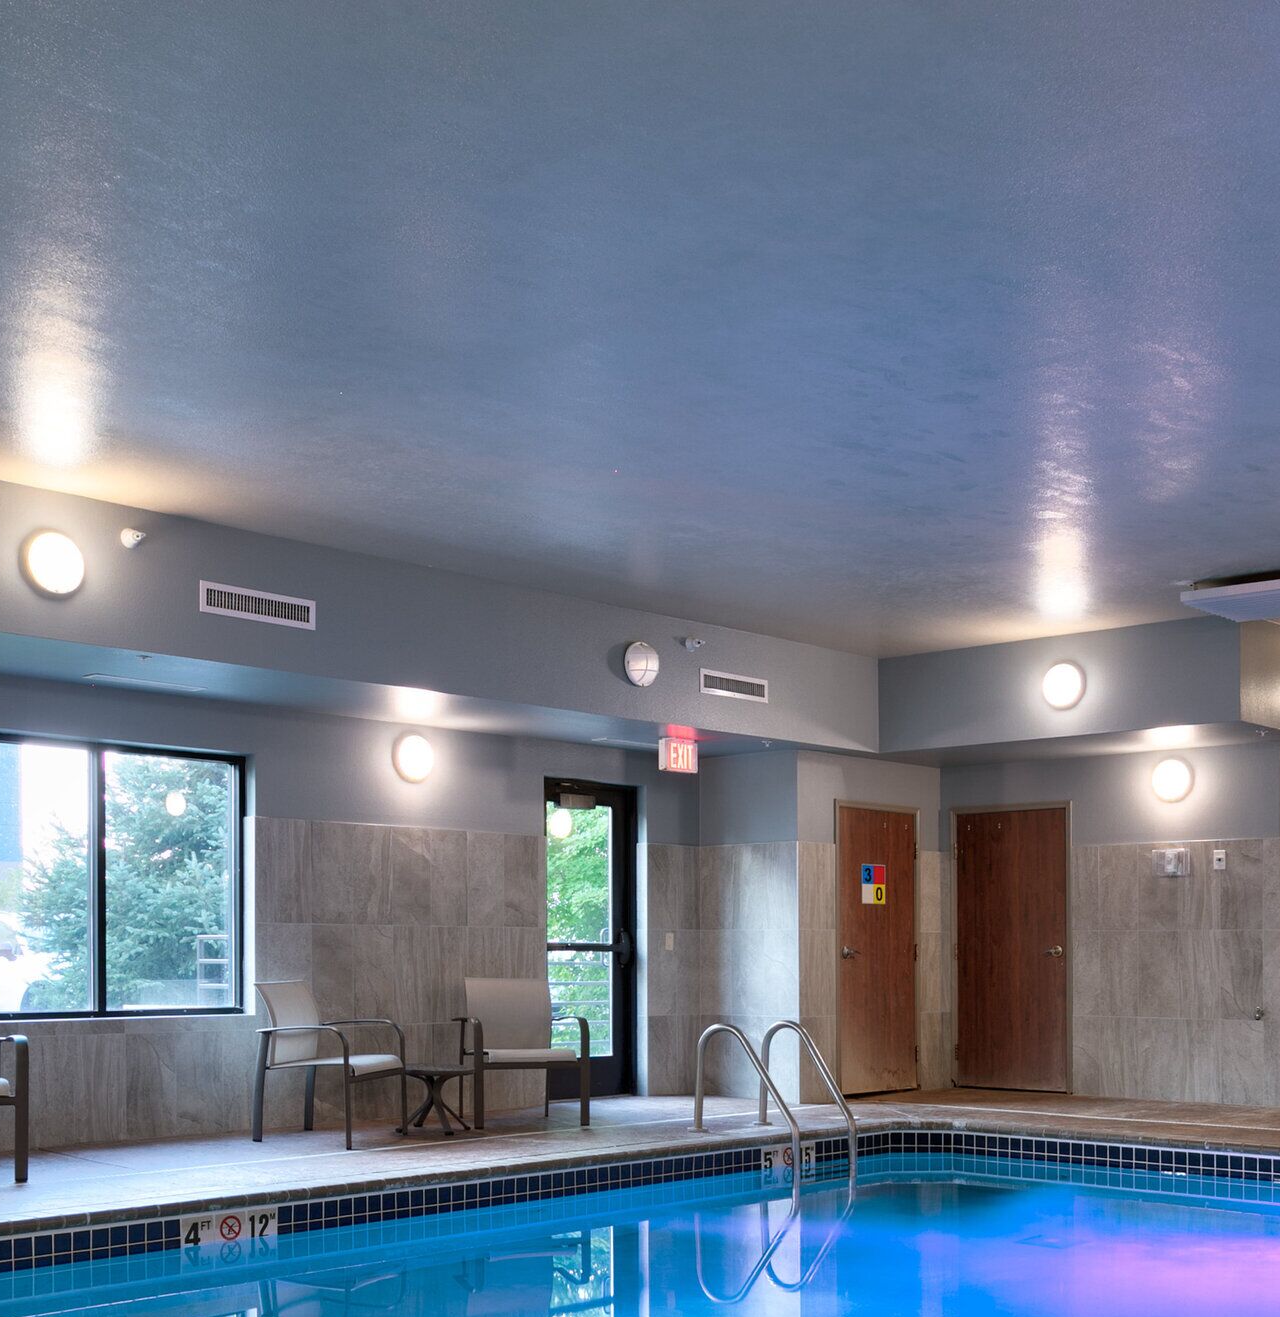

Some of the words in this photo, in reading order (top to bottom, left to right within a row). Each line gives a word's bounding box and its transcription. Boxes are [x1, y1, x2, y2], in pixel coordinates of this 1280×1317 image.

[670, 742, 693, 769] EXIT
[864, 867, 872, 882] 3
[876, 887, 883, 901] 0
[763, 1151, 773, 1169] 5
[184, 1222, 202, 1246] 4
[201, 1220, 212, 1231] FT
[249, 1214, 270, 1238] 12
